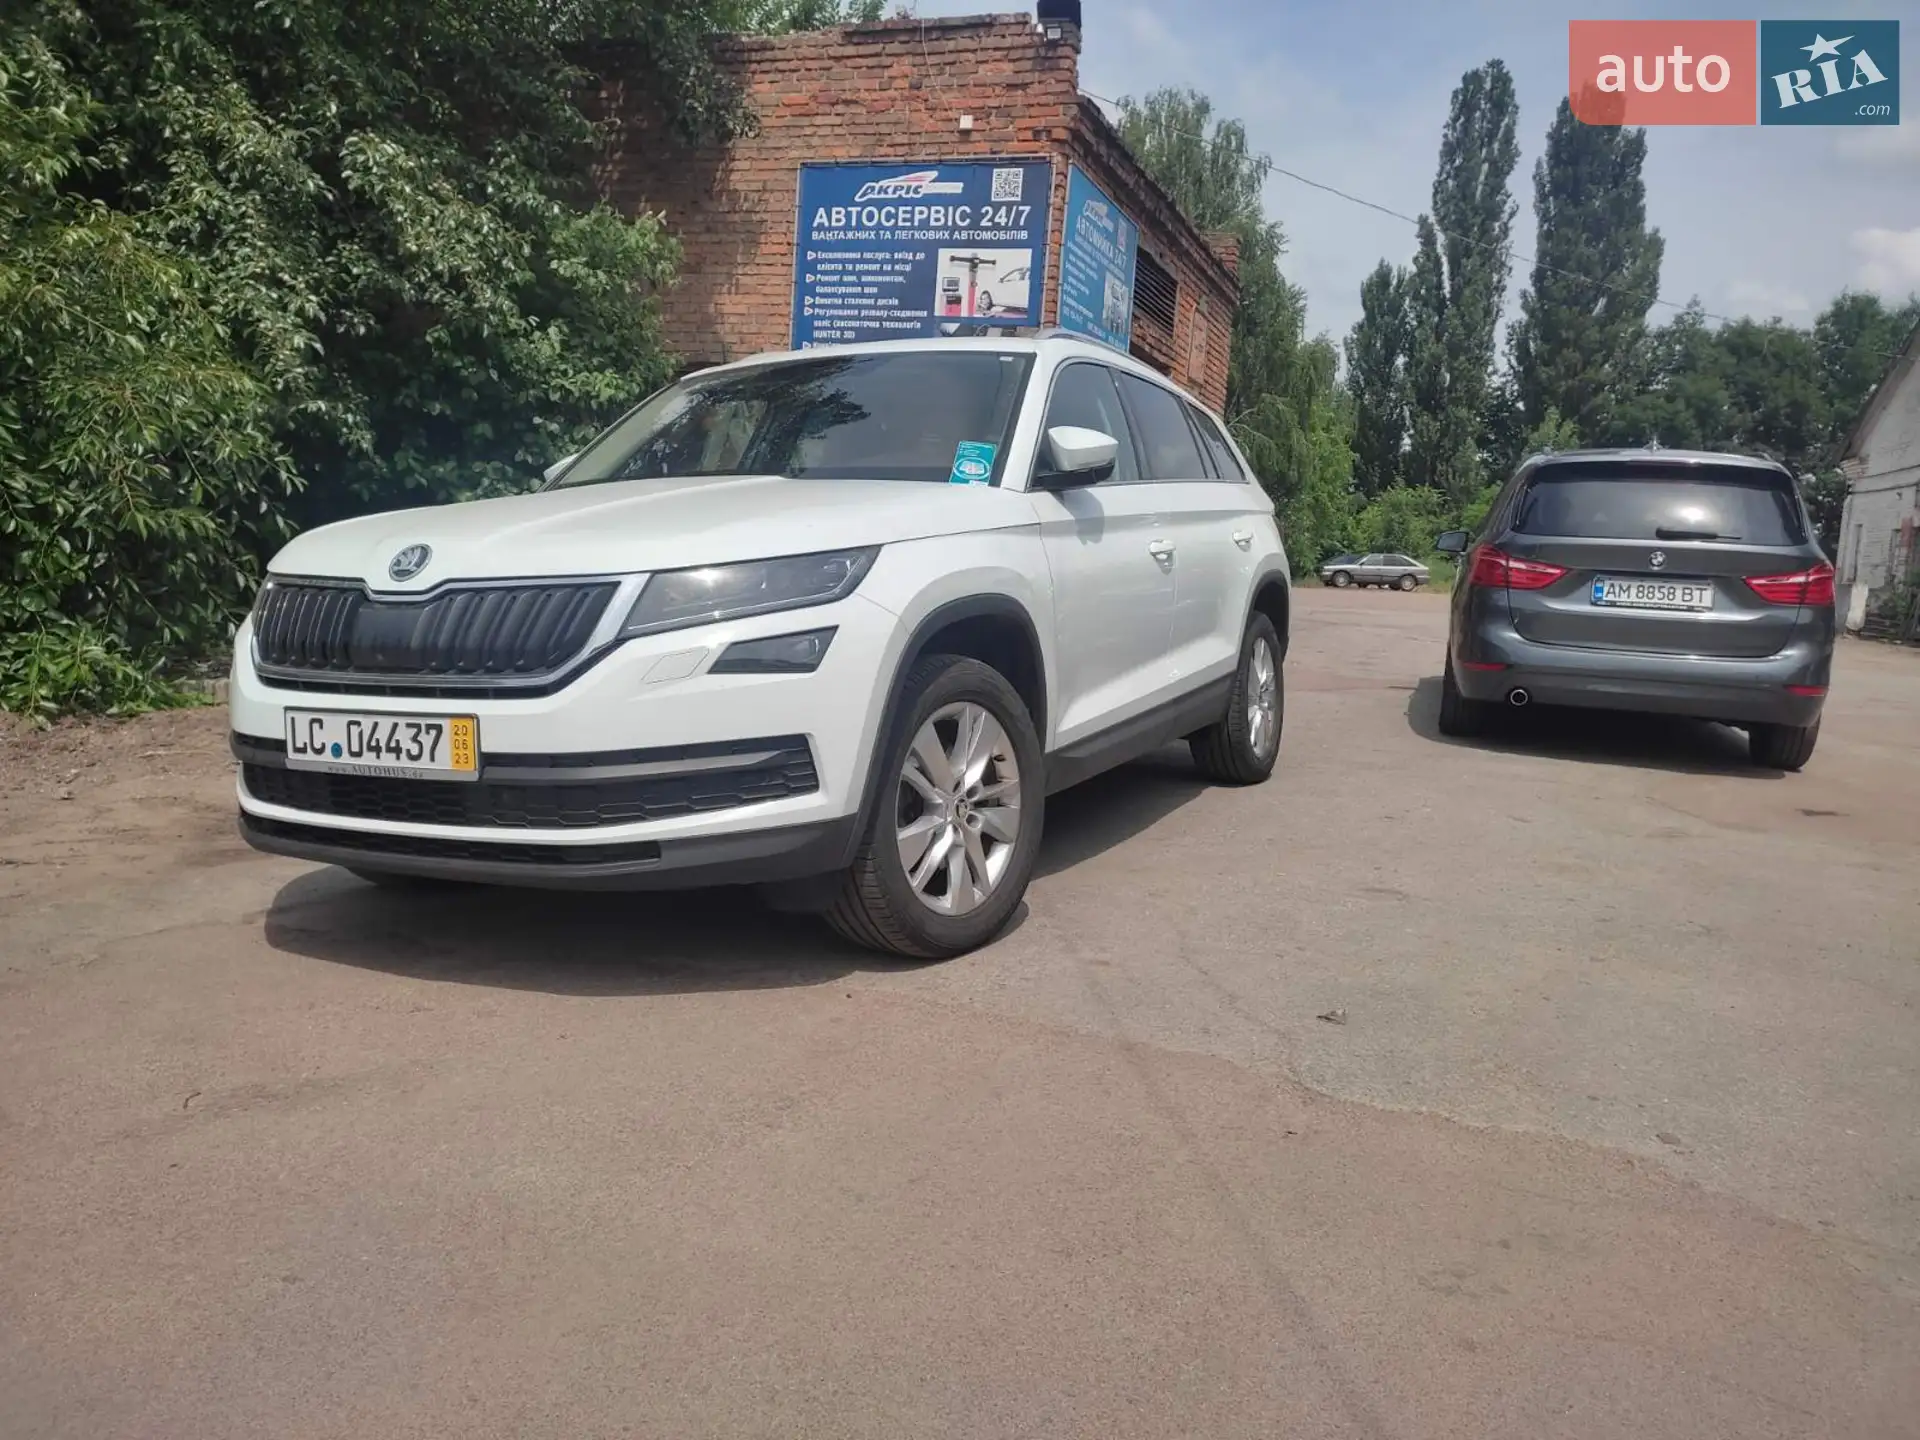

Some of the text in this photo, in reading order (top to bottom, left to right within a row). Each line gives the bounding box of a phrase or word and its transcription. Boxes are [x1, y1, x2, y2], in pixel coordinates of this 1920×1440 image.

[812, 205, 1032, 228] АВТОСЕРВІС 24/7
[811, 230, 1029, 241] ВАНТАЖНИХ ТА ЛЕГКОВИХ АВТОМОБІЛІВ
[1606, 582, 1708, 603] AM 8858 BT
[454, 724, 468, 736] 20
[290, 716, 443, 763] LC 04437
[454, 738, 469, 749] 06
[454, 752, 469, 765] 23
